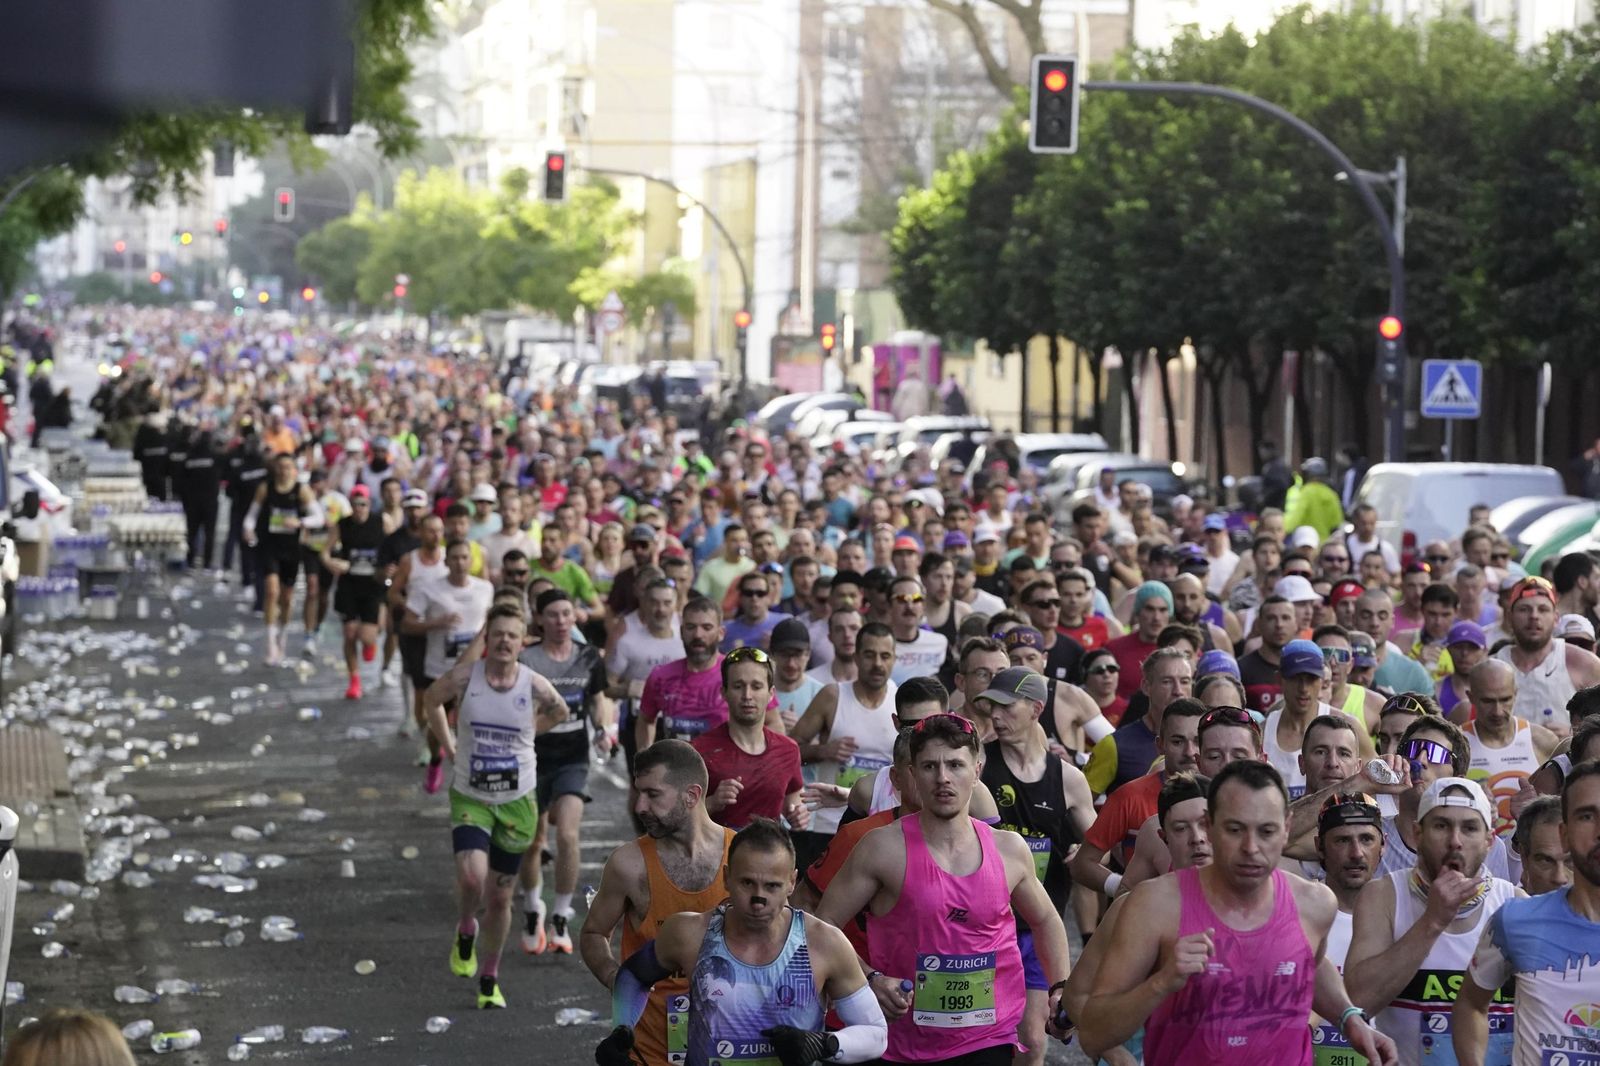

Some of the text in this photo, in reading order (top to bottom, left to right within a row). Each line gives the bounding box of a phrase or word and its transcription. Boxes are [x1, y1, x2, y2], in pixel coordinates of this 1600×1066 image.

[946, 957, 988, 969] ZURICH
[945, 981, 970, 991] 2728
[939, 995, 974, 1010] 1993
[740, 1043, 775, 1055] ZURI
